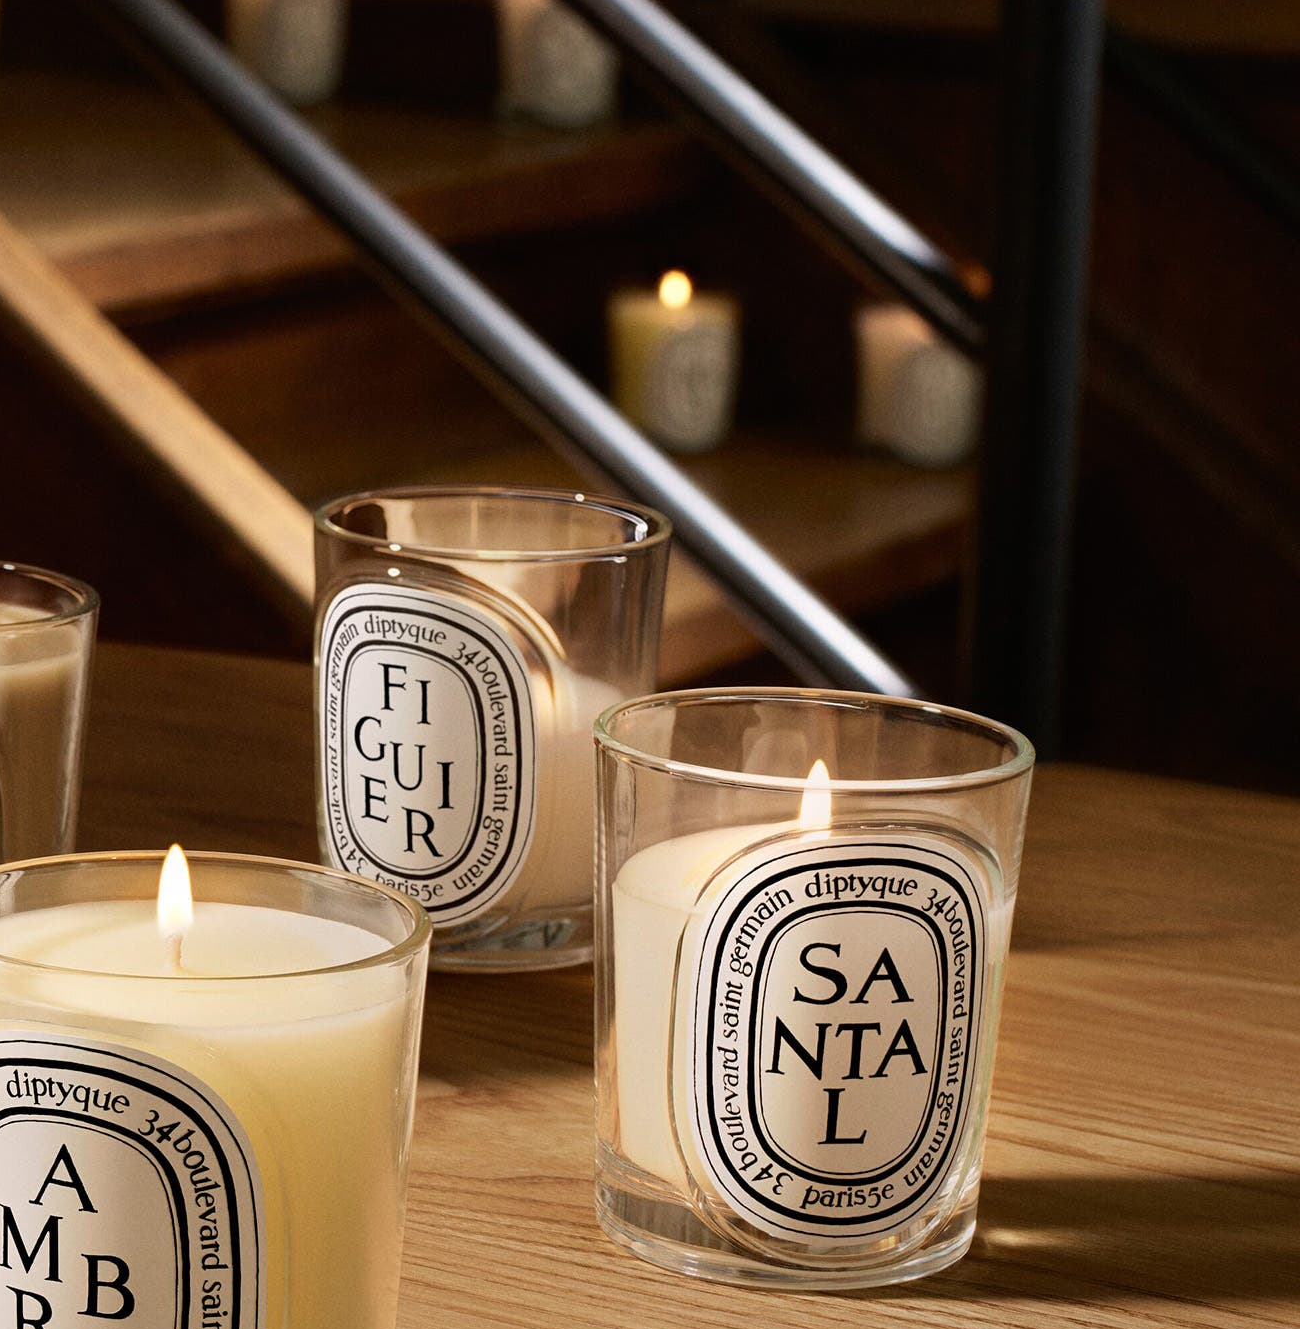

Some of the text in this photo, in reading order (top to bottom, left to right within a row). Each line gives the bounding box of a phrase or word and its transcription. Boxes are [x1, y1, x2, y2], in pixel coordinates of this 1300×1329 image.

[364, 614, 447, 647] diptyque
[494, 763, 513, 813] saint
[452, 815, 504, 892] germain
[805, 872, 919, 900] diptyque
[729, 887, 795, 978] germain
[719, 981, 744, 1042] saint
[947, 1026, 963, 1087] saint
[6, 1070, 130, 1114] diptyque
[903, 1090, 955, 1189] germain
